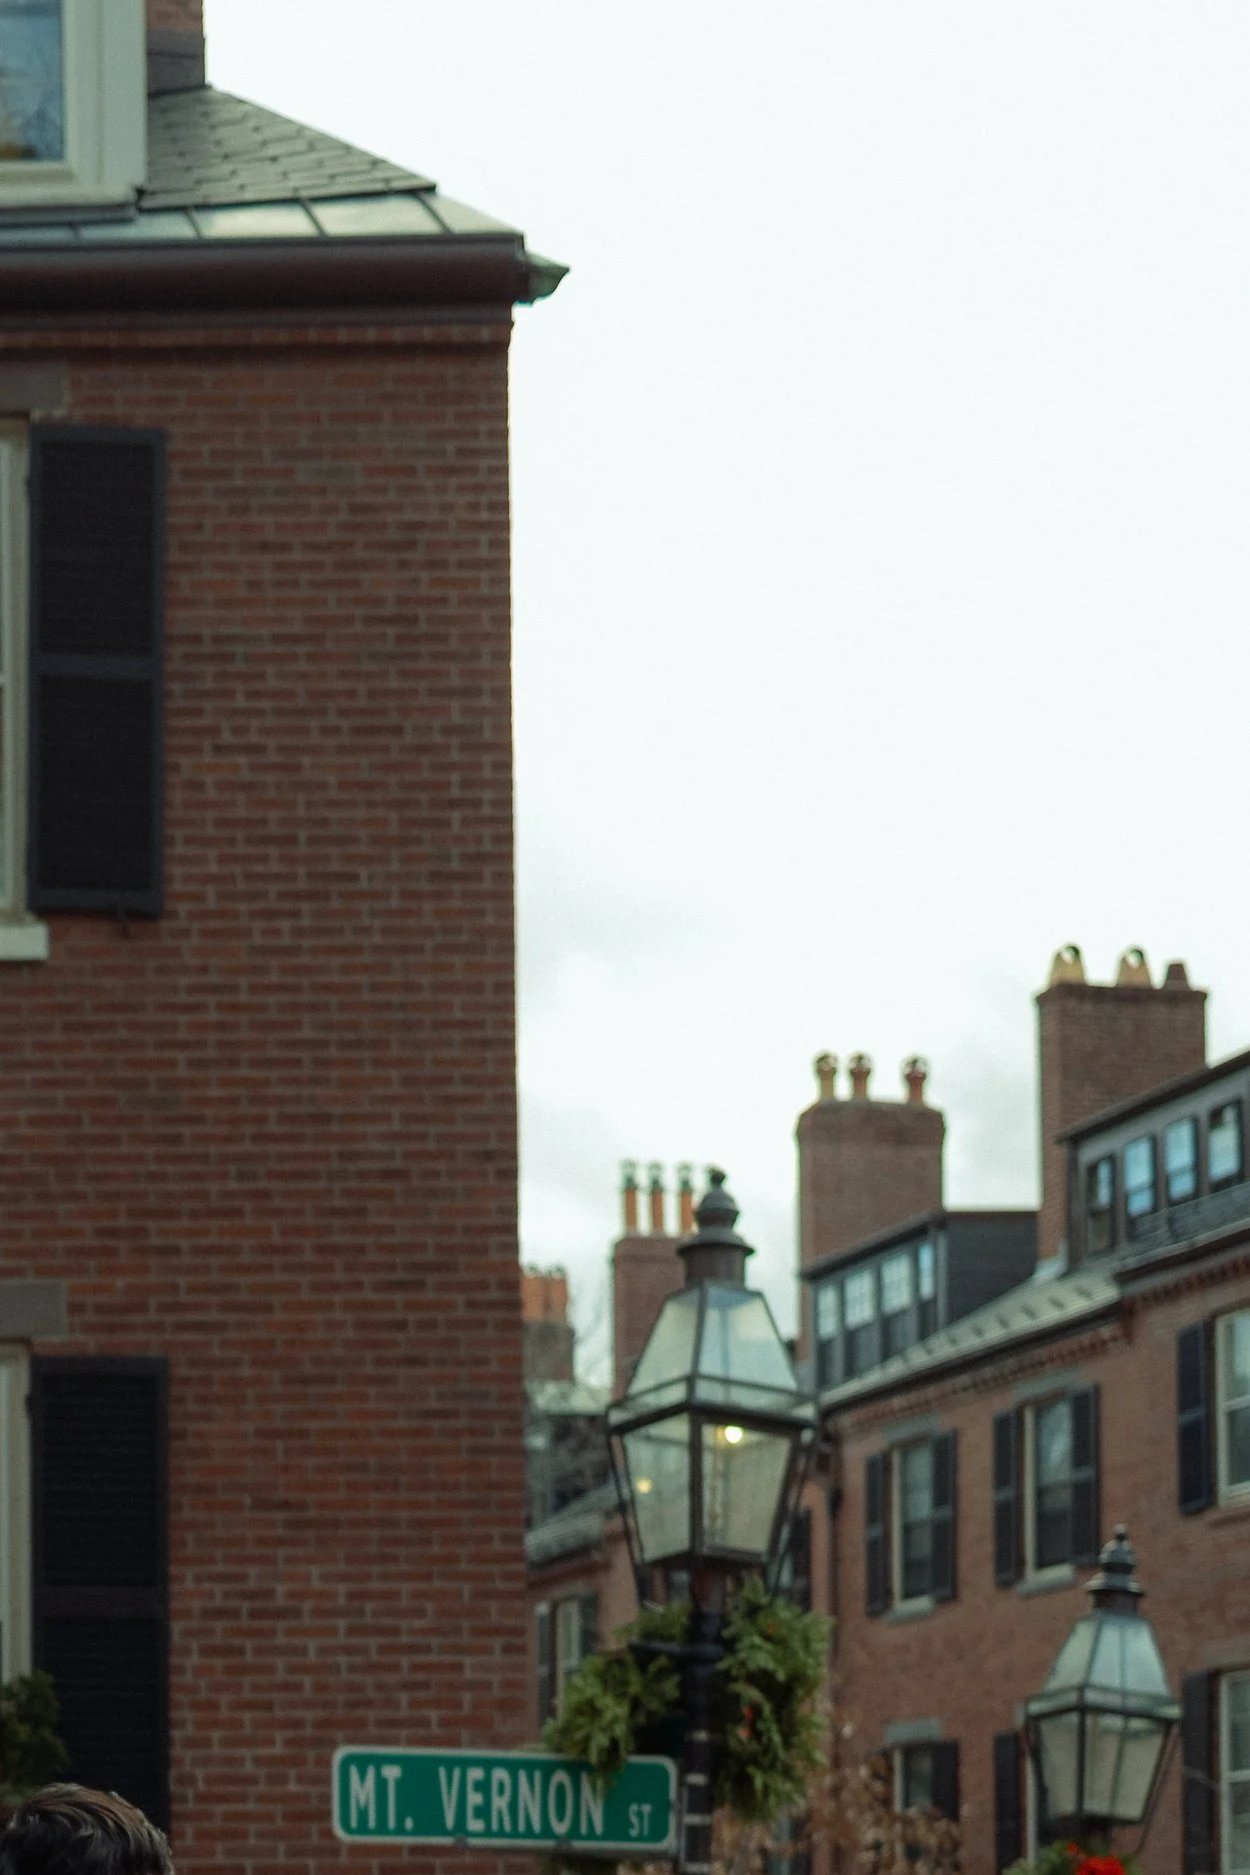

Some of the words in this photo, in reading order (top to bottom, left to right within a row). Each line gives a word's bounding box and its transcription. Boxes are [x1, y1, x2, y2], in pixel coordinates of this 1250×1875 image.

[350, 1764, 414, 1831] MT.
[439, 1766, 605, 1836] VERNON
[628, 1803, 652, 1838] ST
